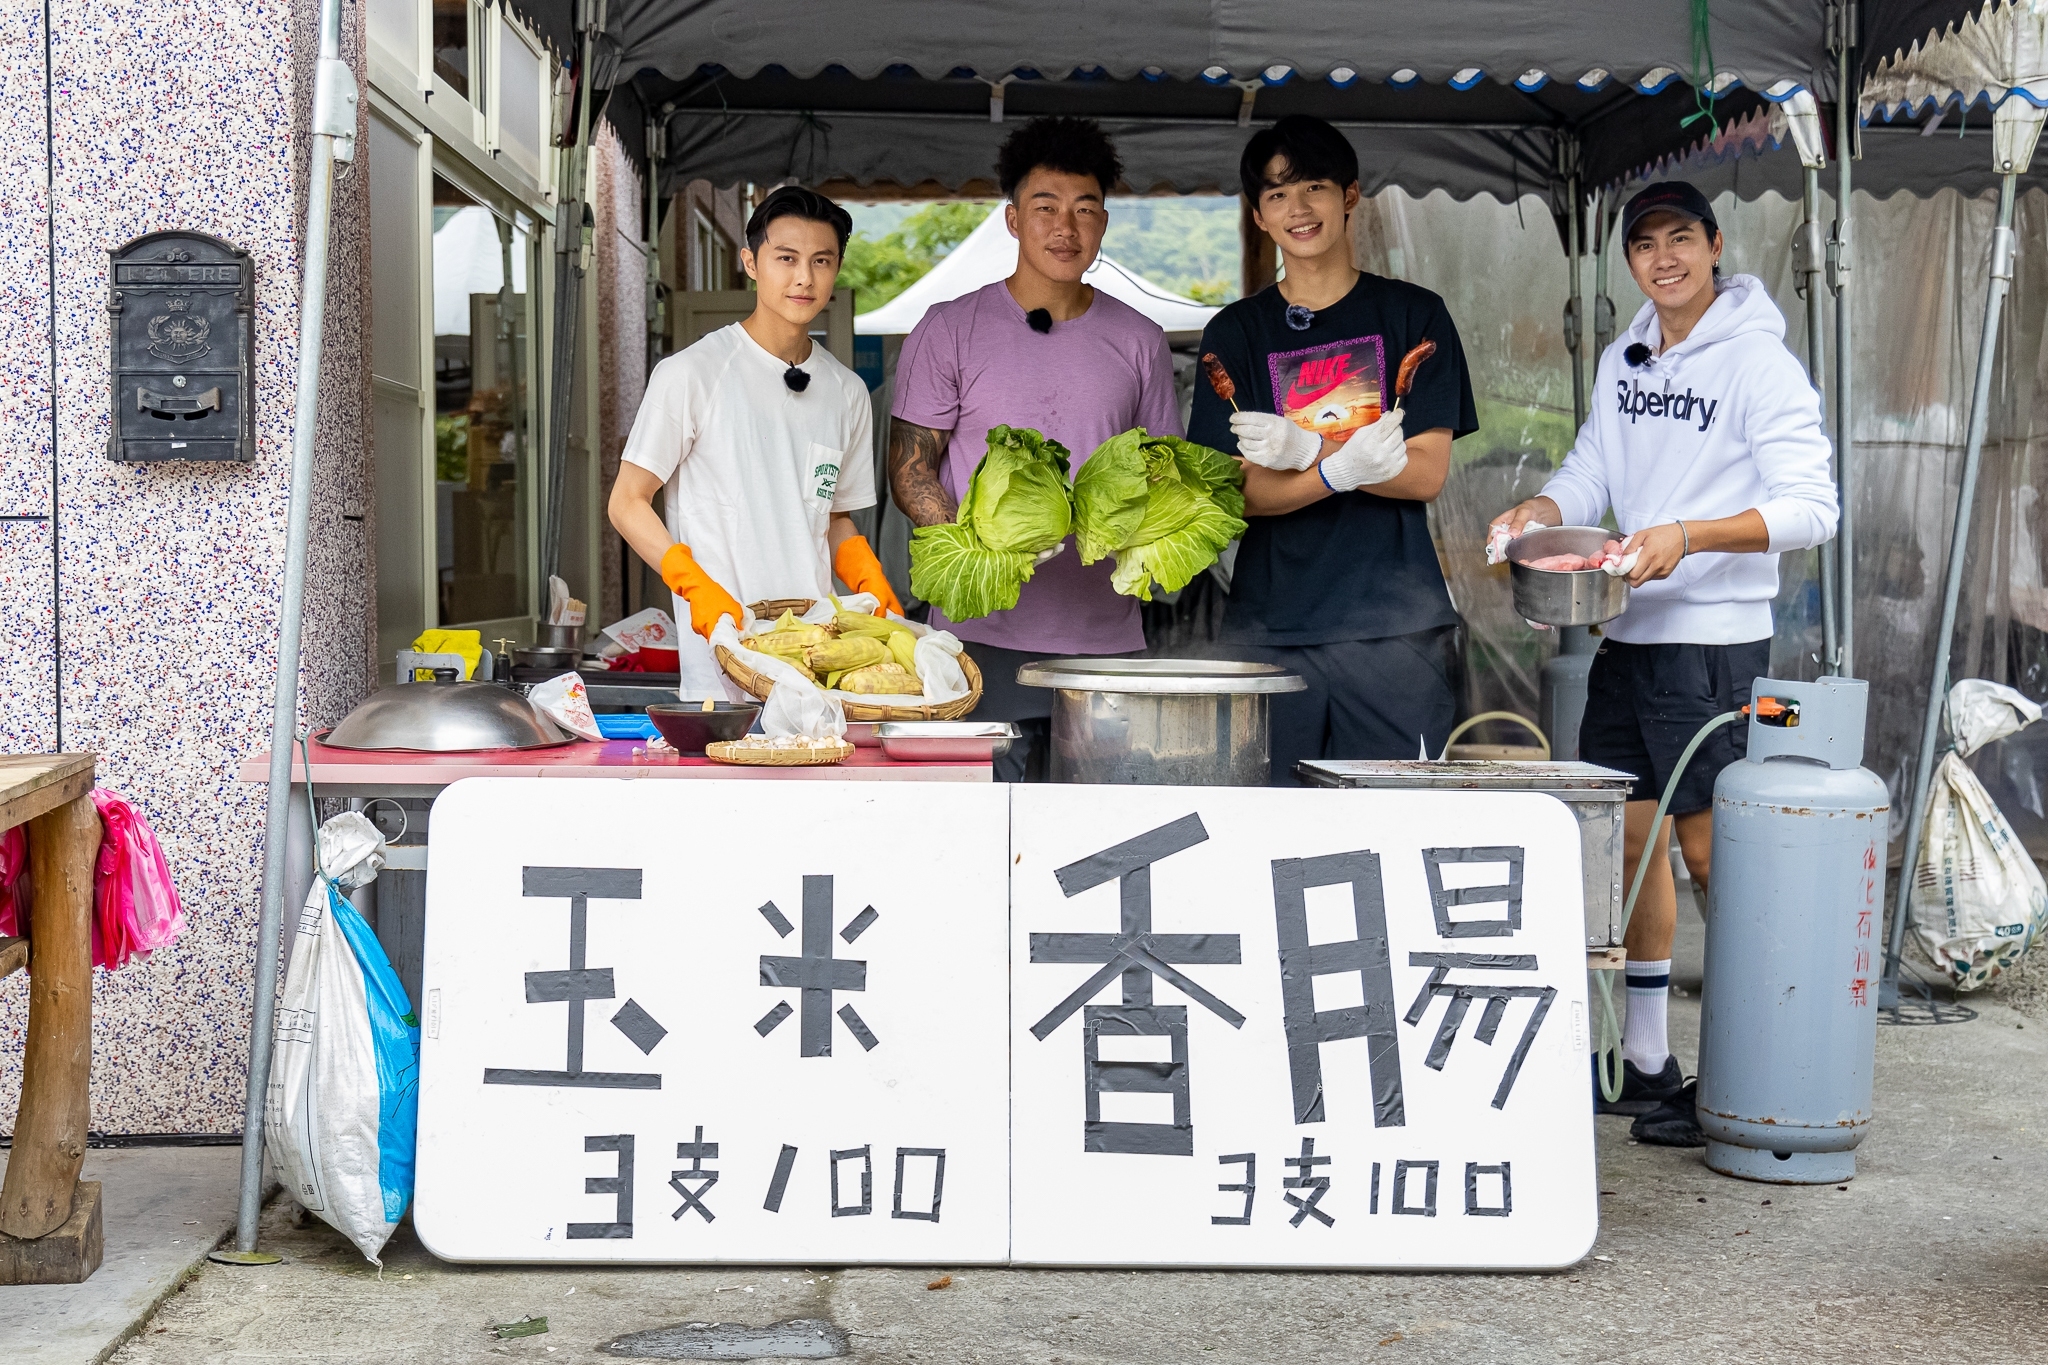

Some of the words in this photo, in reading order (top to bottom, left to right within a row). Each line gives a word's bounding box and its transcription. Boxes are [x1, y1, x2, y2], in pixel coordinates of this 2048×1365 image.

[1297, 353, 1351, 387] NIKE
[483, 866, 879, 1089] 玉米
[1029, 812, 1558, 1156] 香腸
